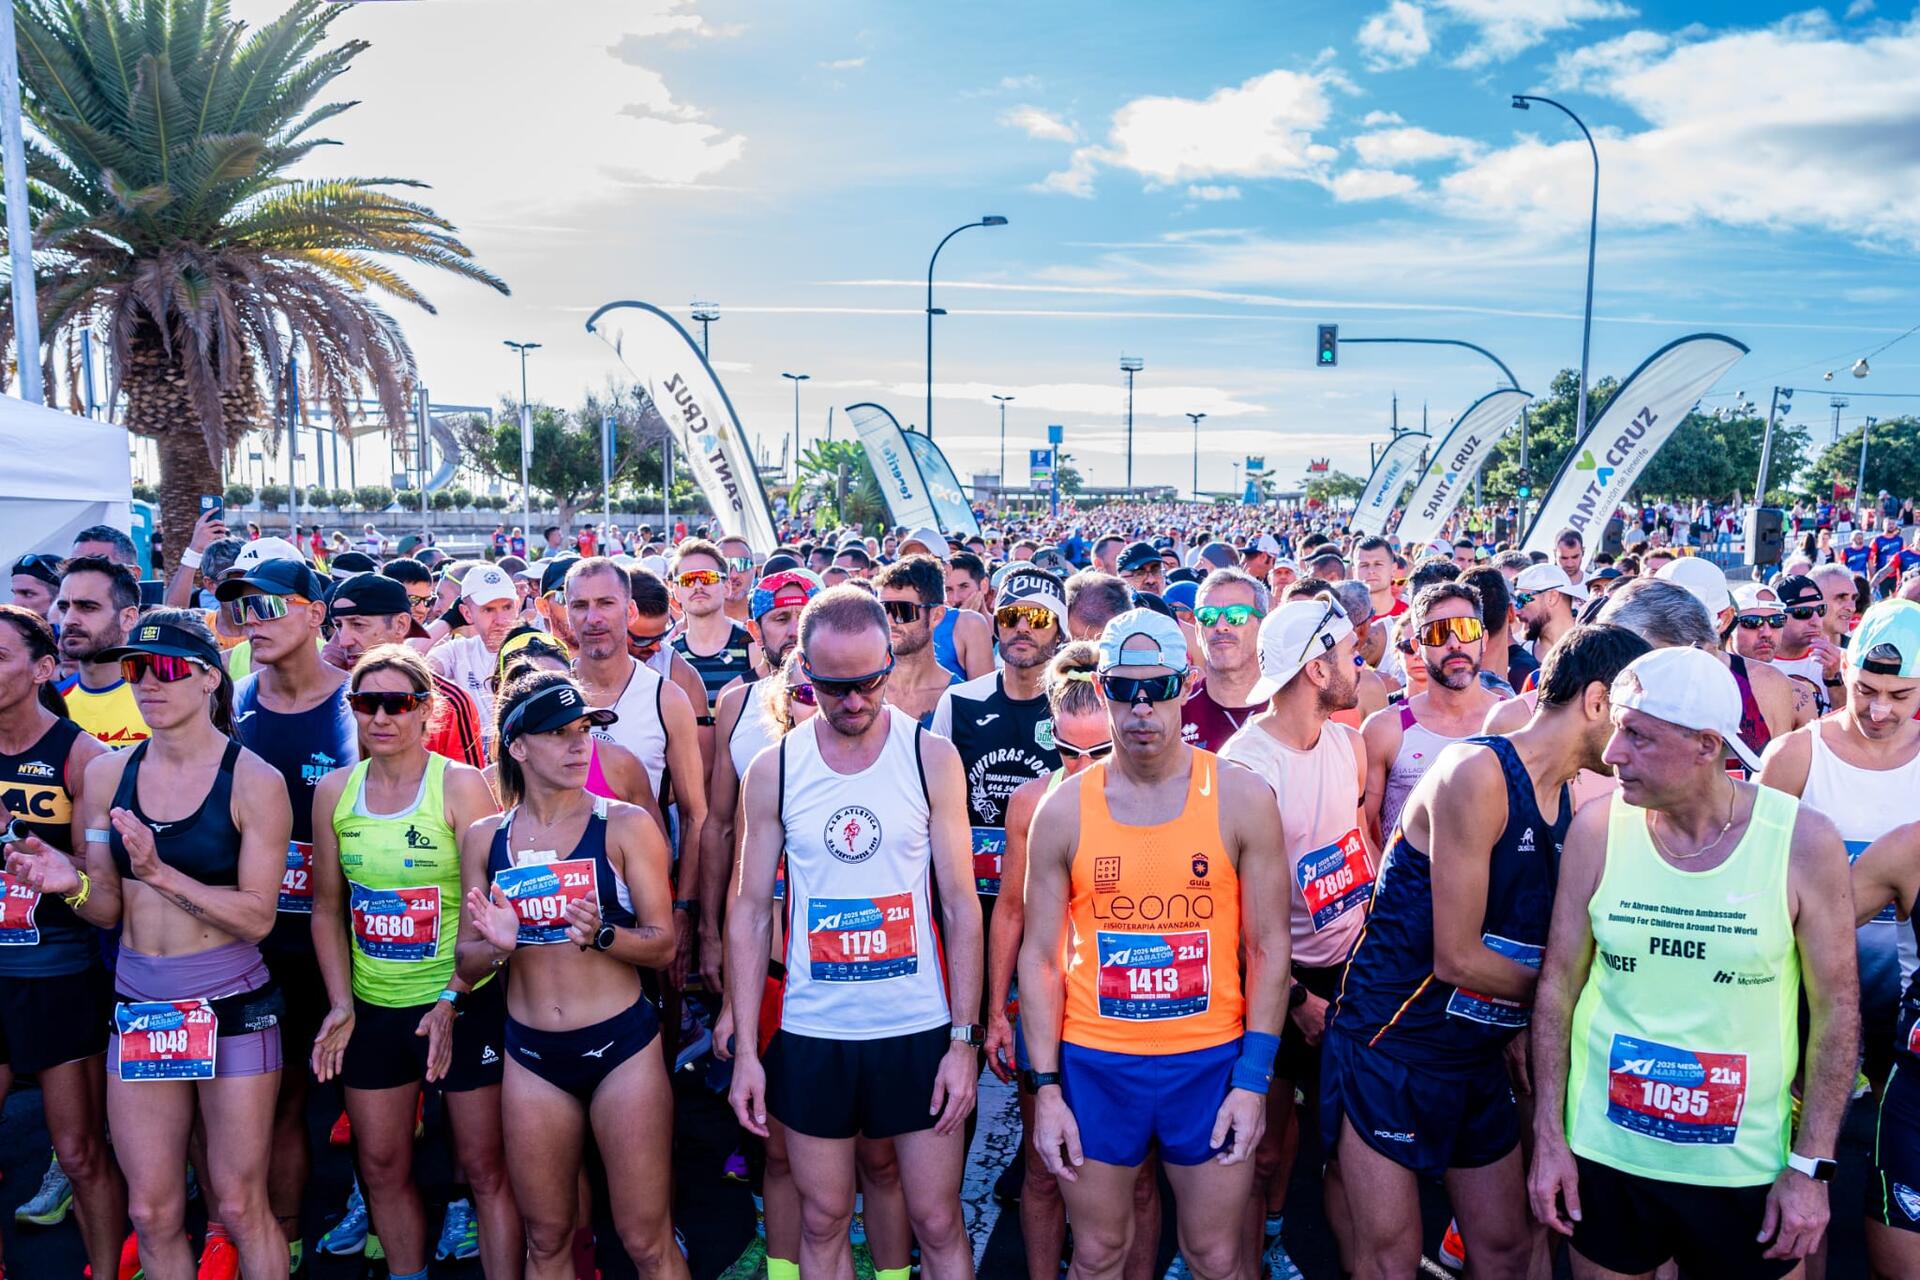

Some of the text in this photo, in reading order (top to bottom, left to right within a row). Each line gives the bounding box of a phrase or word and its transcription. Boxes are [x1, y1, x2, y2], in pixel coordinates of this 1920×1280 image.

[1606, 406, 1659, 466] CRUZ
[1451, 434, 1482, 472] CRUZ
[968, 747, 1051, 785] PINTURAS JOR
[0, 788, 58, 818] AC
[844, 808, 877, 830] ATLETICA
[282, 869, 308, 890] 42
[563, 873, 590, 887] 21K
[1315, 864, 1354, 901] 2805
[410, 899, 435, 911] 21K
[518, 895, 567, 920] 1097
[887, 906, 911, 922] 21K
[1091, 894, 1214, 920] Leona
[1620, 900, 1632, 909] Per
[1660, 905, 1694, 917] Children
[1696, 908, 1747, 920] Ambassador
[364, 915, 414, 938] 2680
[1103, 921, 1201, 931] FISIOTERAPIA AVANZADA
[1608, 913, 1758, 936] Running For Children Around The World
[838, 929, 887, 955] 1179
[1178, 945, 1204, 960] 21K
[1649, 937, 1707, 960] PEACE
[1126, 968, 1178, 993] 1413
[187, 1009, 212, 1024] 21K
[146, 1029, 188, 1054] 1048
[1612, 1058, 1656, 1076] XI
[1677, 1062, 1703, 1070] MEDIA
[1709, 1067, 1741, 1085] 21K
[1641, 1081, 1709, 1117] 1035
